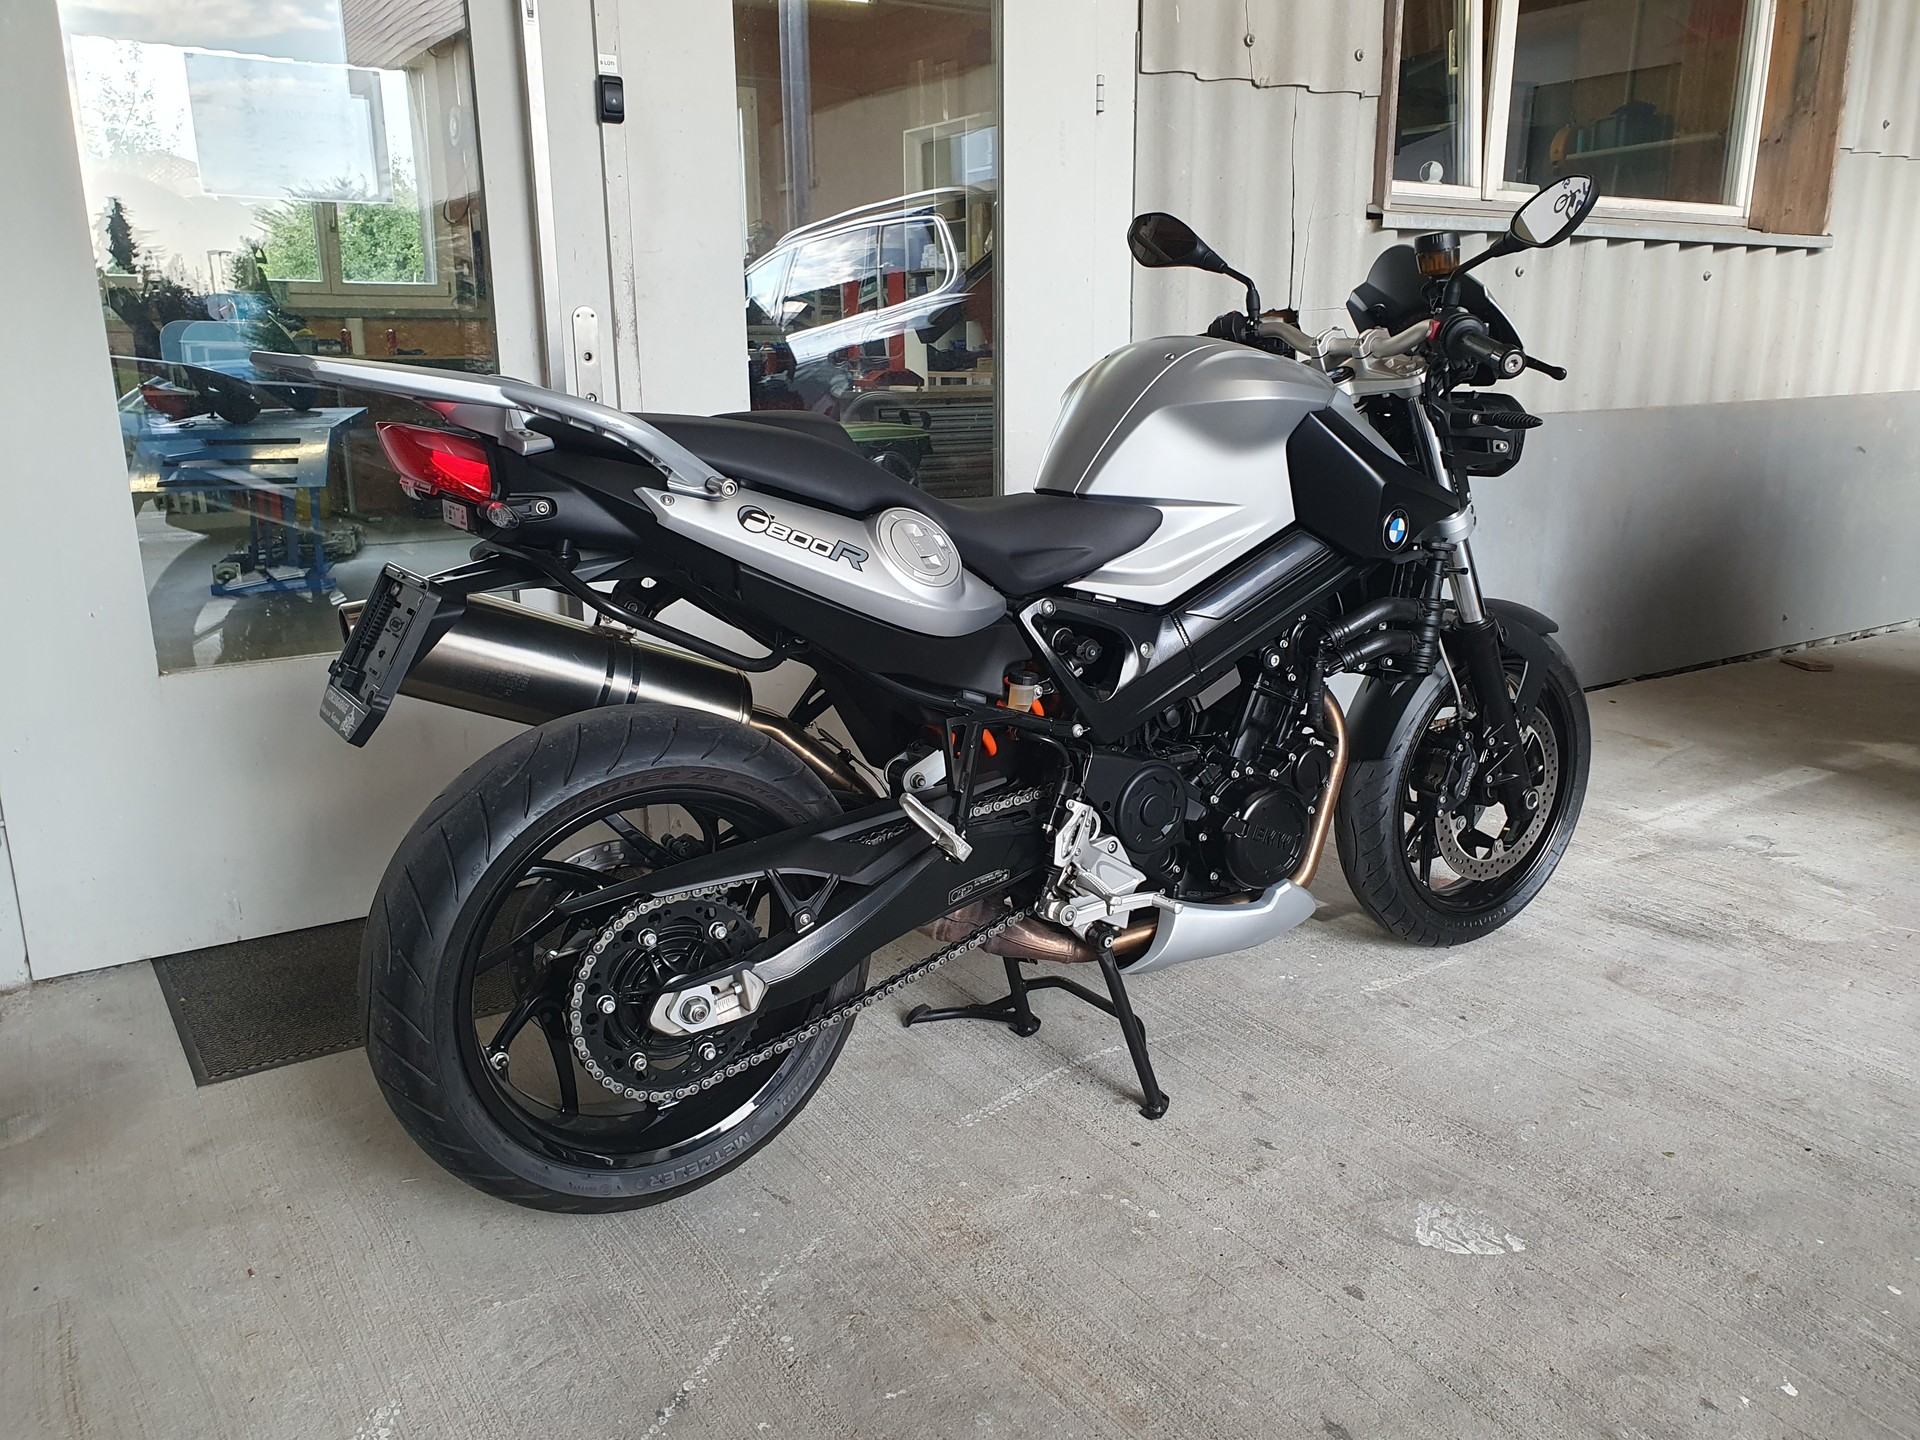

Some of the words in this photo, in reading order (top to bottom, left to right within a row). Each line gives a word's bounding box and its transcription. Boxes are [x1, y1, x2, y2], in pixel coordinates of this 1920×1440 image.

[737, 505, 869, 572] F800R
[1460, 762, 1475, 796] brembo
[1252, 825, 1292, 850] BMW
[649, 1131, 752, 1187] METZELER
